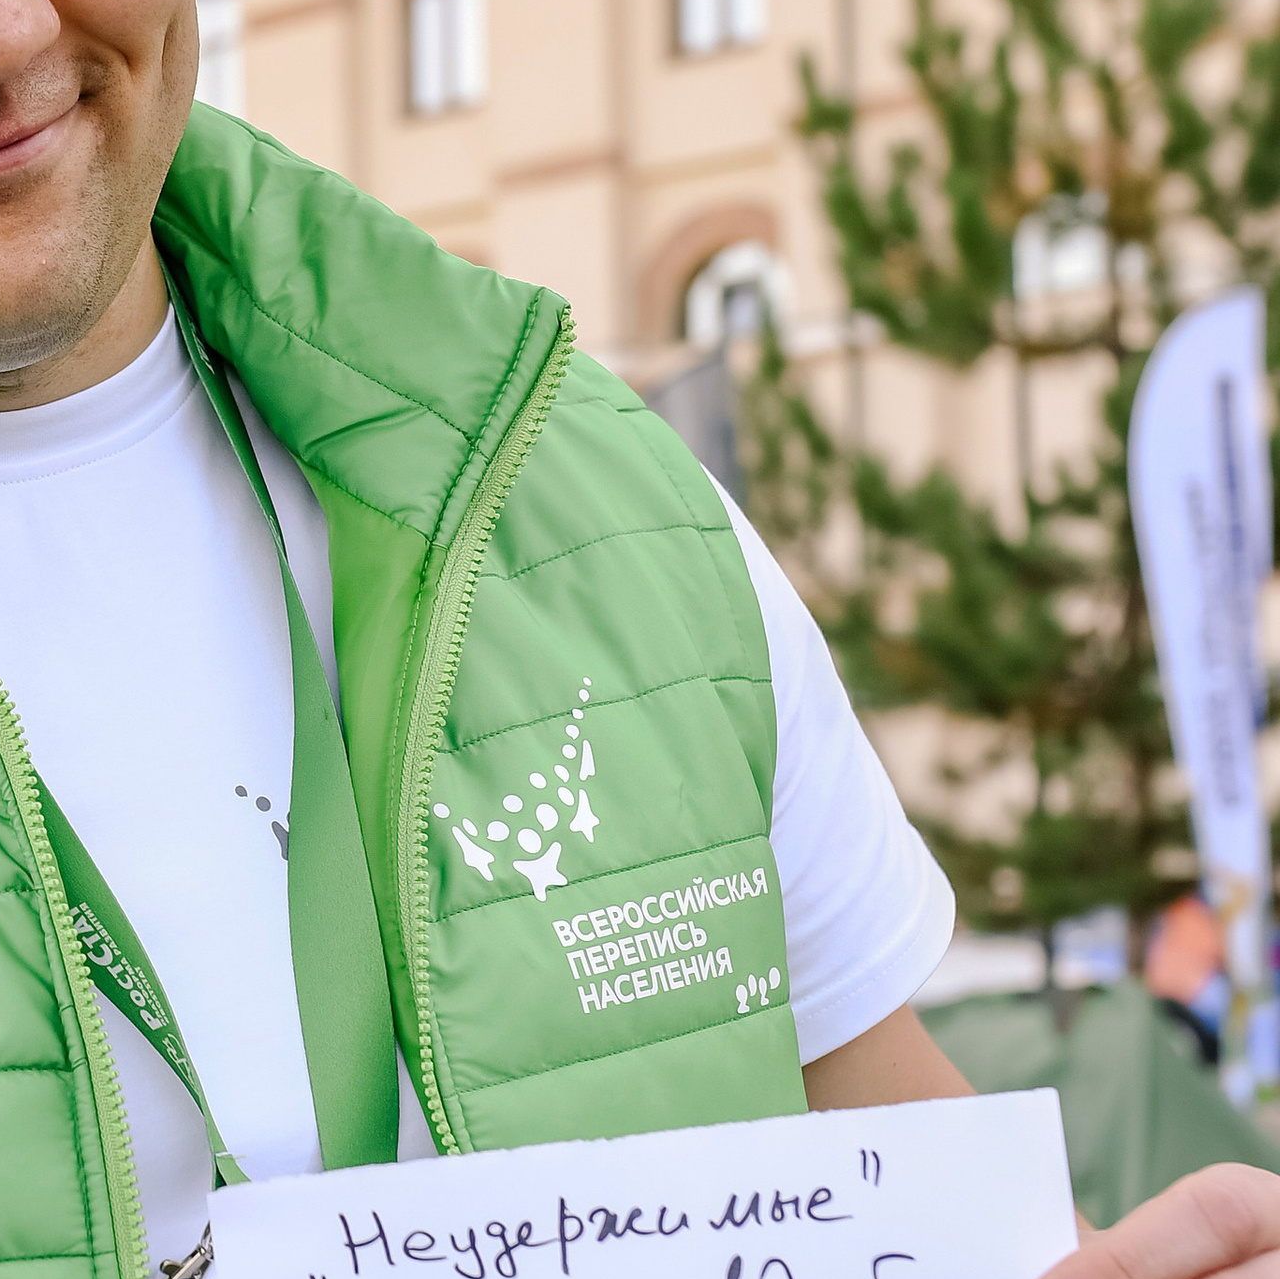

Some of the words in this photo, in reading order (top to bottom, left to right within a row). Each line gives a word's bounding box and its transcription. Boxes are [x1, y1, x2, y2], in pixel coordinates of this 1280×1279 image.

[552, 867, 769, 947] ВСЕРОССИЙСКАЯ
[566, 921, 708, 979] ПЕРЕПИСЬ
[577, 947, 734, 1014] НАСЕЛЕНИЯ
